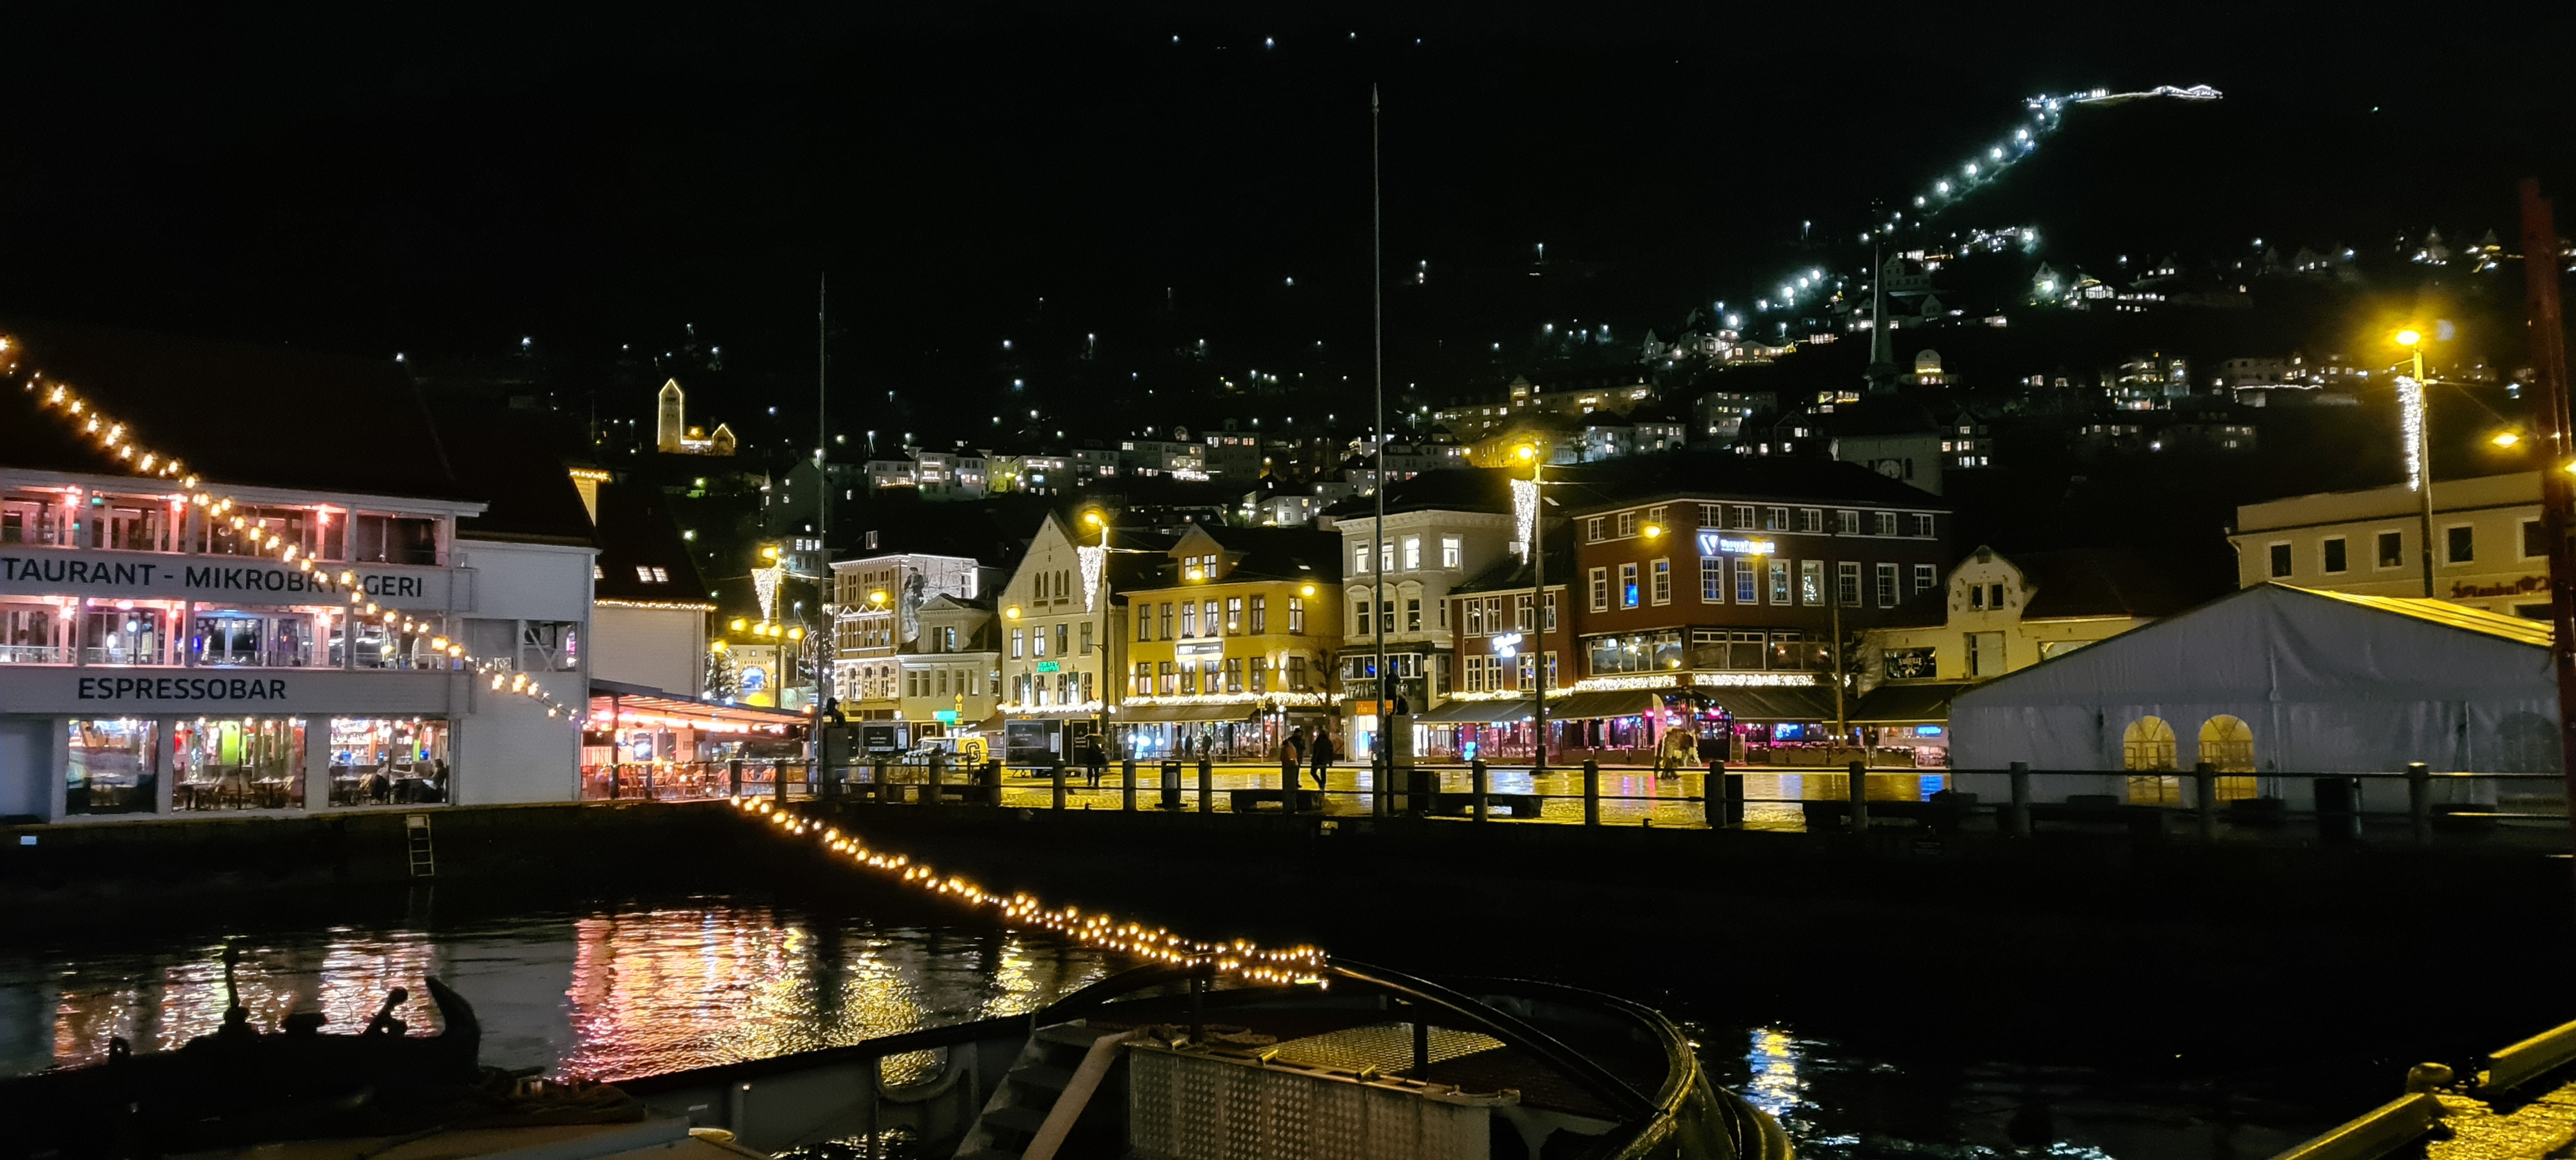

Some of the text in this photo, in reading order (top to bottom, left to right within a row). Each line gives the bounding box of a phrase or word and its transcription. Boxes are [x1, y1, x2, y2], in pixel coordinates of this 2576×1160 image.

[1, 558, 156, 586] TAURANT
[78, 677, 286, 699] ESPRESSOBAR
[965, 742, 981, 763] G
